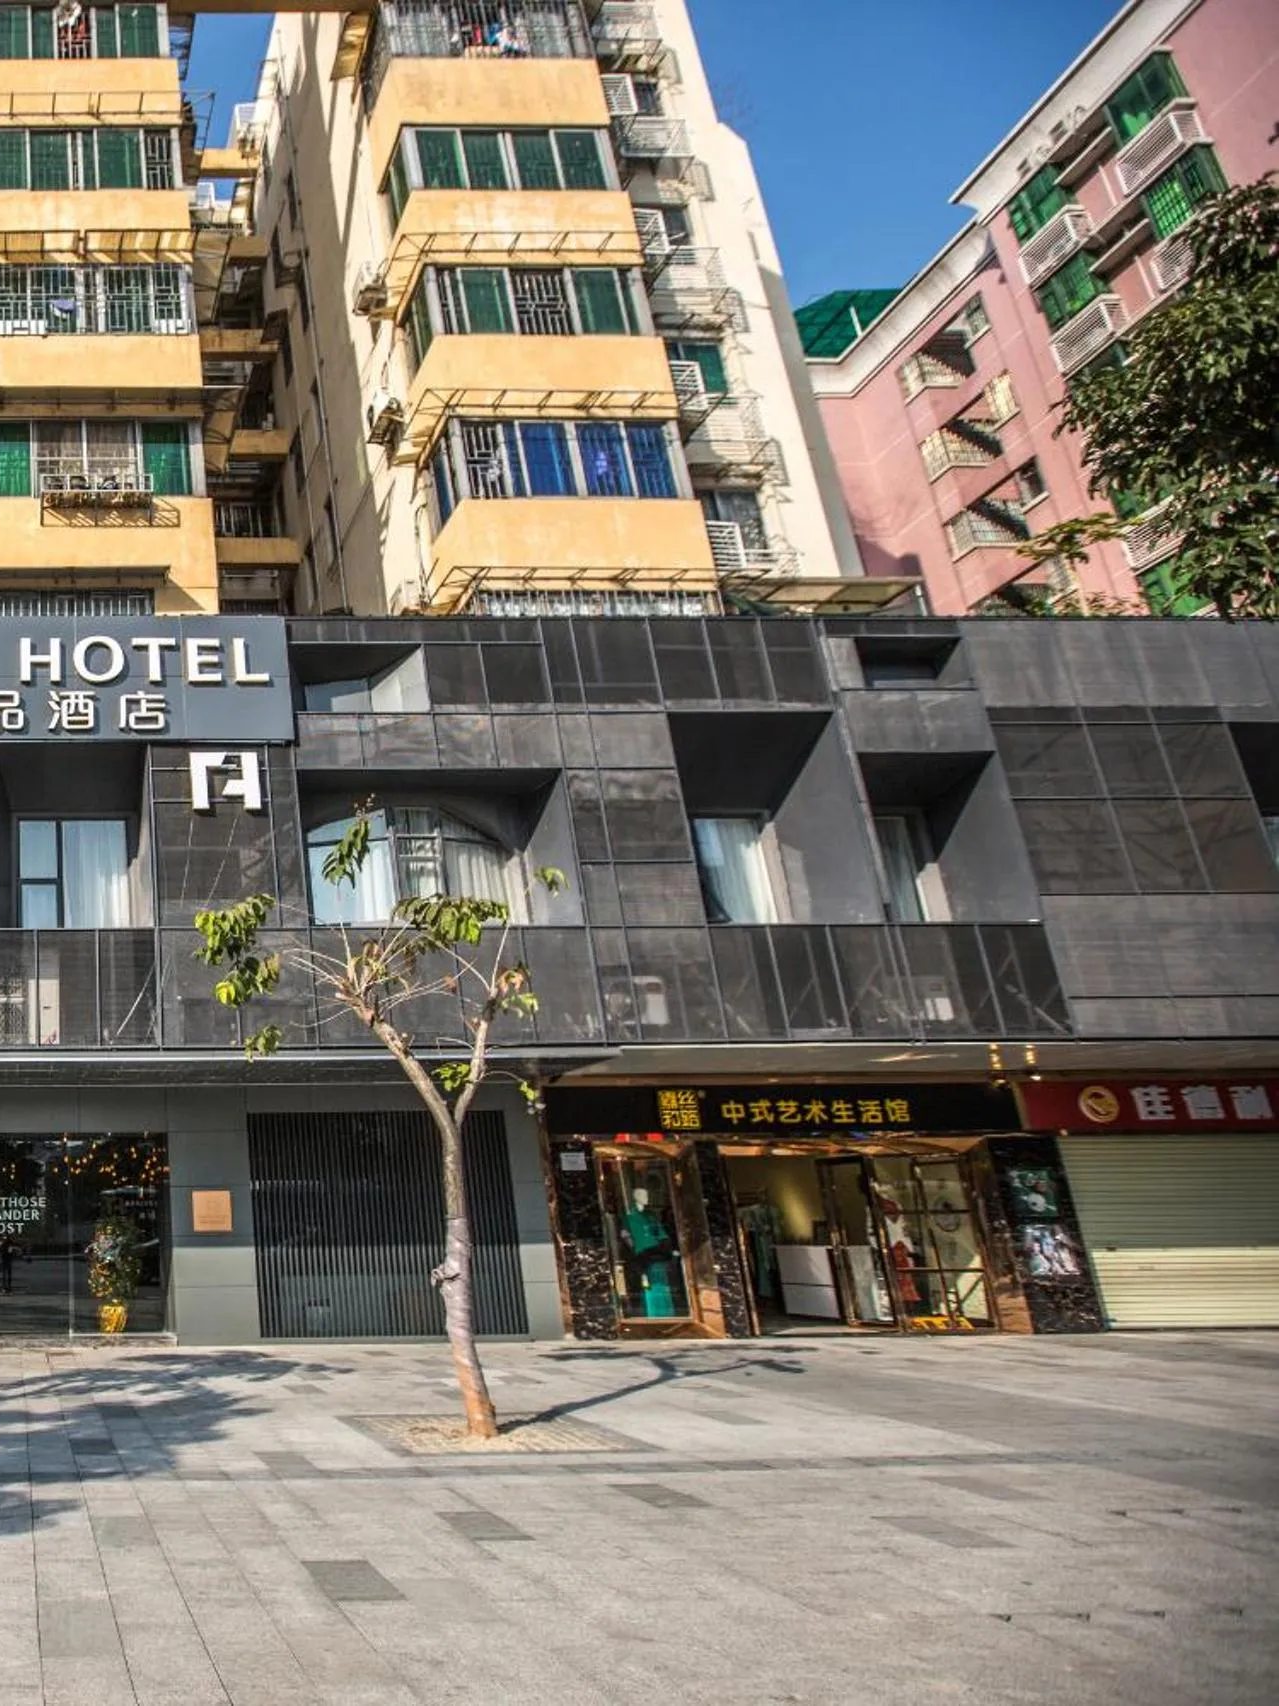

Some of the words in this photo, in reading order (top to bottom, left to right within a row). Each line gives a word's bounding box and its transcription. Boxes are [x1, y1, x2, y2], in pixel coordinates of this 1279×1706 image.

[20, 635, 270, 684] HOTEL
[722, 1098, 911, 1125] 中式艺术生活馆
[0, 1196, 47, 1208] THOSE
